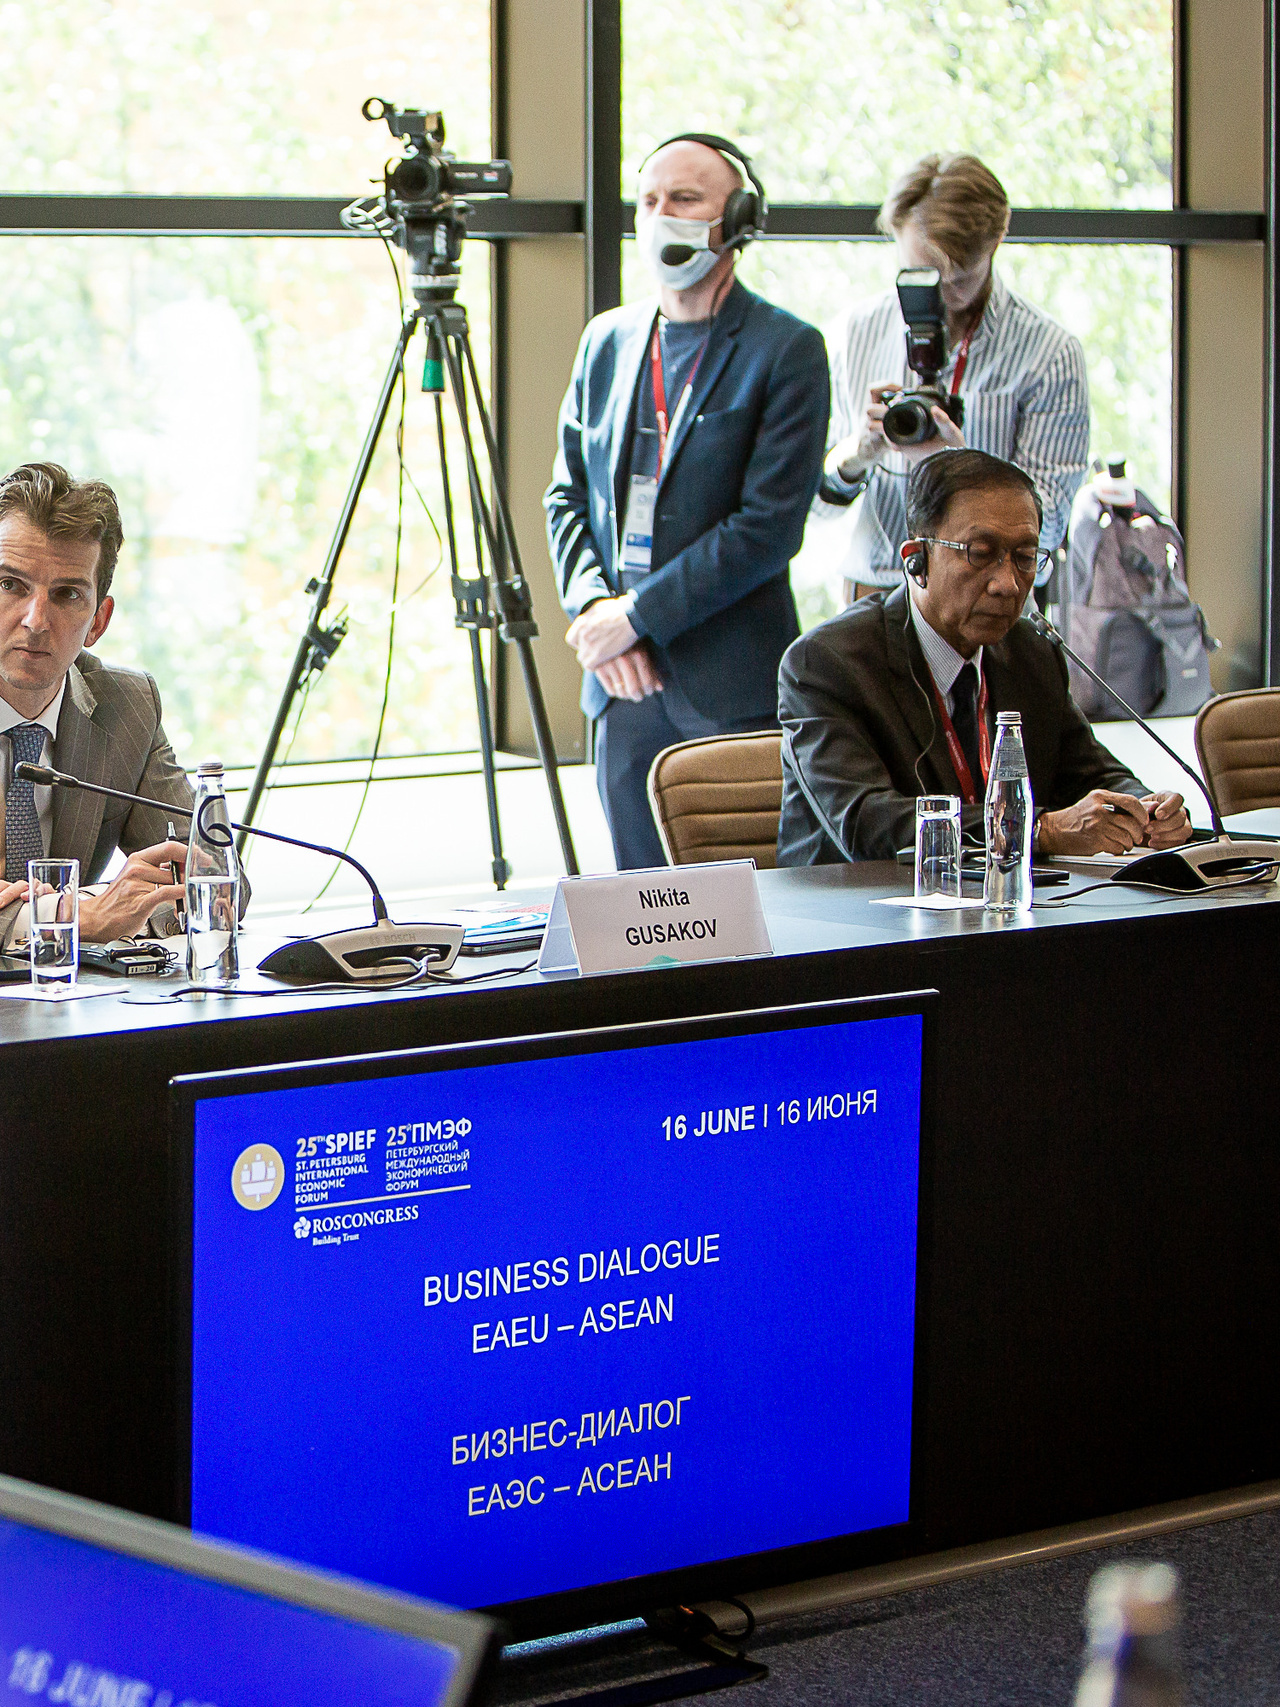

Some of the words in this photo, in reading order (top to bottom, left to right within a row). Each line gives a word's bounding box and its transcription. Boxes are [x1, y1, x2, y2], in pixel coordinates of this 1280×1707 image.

[639, 888, 690, 909] Nikita
[625, 919, 717, 946] GUSAKOV
[661, 1115, 687, 1141] 16
[693, 1105, 755, 1137] JUNE
[776, 1099, 801, 1126] 16
[807, 1089, 877, 1122] ИЮНЯ
[386, 1140, 458, 1159] ПЕТЕРБУРГСКИЙ
[386, 1149, 470, 1170] МЕЖДУНАРОДНЫЙ
[295, 1161, 309, 1171] ST.
[309, 1153, 366, 1169] PETERSBURG
[386, 1160, 468, 1181] ЭКОНОМИЧЕСКИЙ
[295, 1164, 369, 1182] INTERNATIONAL
[295, 1177, 346, 1193] ECONOMIC
[385, 1180, 419, 1192] ФОРУМ
[295, 1191, 329, 1205] FORUM
[312, 1204, 419, 1234] ROSCONGRESS
[312, 1234, 342, 1247] Building
[342, 1233, 360, 1242] Trust
[423, 1257, 570, 1307] BUSINESS
[578, 1233, 720, 1283] DIALOGUE
[472, 1313, 549, 1354] EAEU
[578, 1293, 673, 1336] ASEAN
[451, 1395, 691, 1466] БИЗНЕС-ДИАЛОГ
[468, 1475, 546, 1516] ЕАЭС
[577, 1451, 672, 1497] АСЕАН
